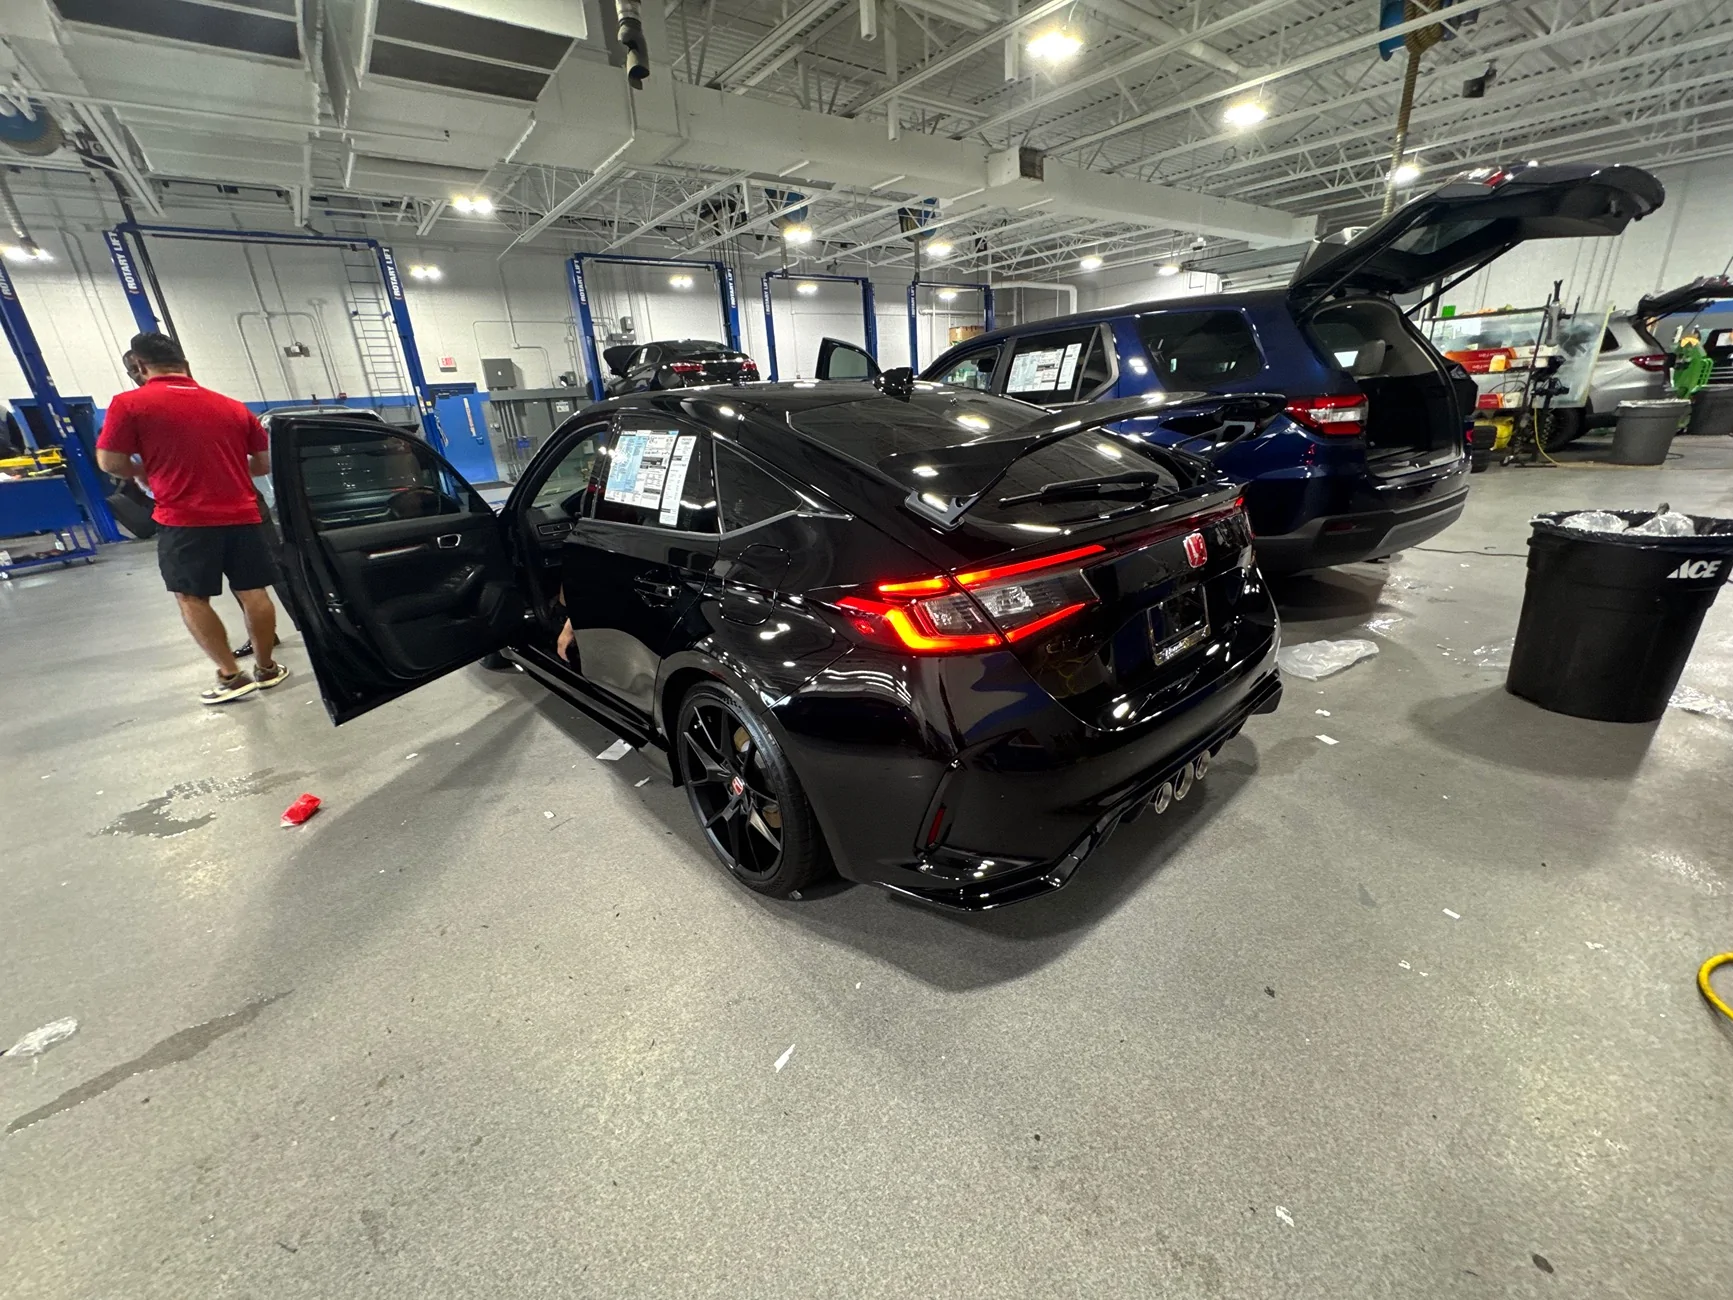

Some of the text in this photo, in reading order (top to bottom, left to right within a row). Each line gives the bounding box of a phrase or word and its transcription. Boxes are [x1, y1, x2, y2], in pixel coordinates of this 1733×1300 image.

[107, 231, 138, 290] ROTARY LIFT
[382, 247, 401, 297] ROTARY LIFT
[573, 259, 587, 302] ROTARY LIFT
[1666, 559, 1723, 579] ACE
